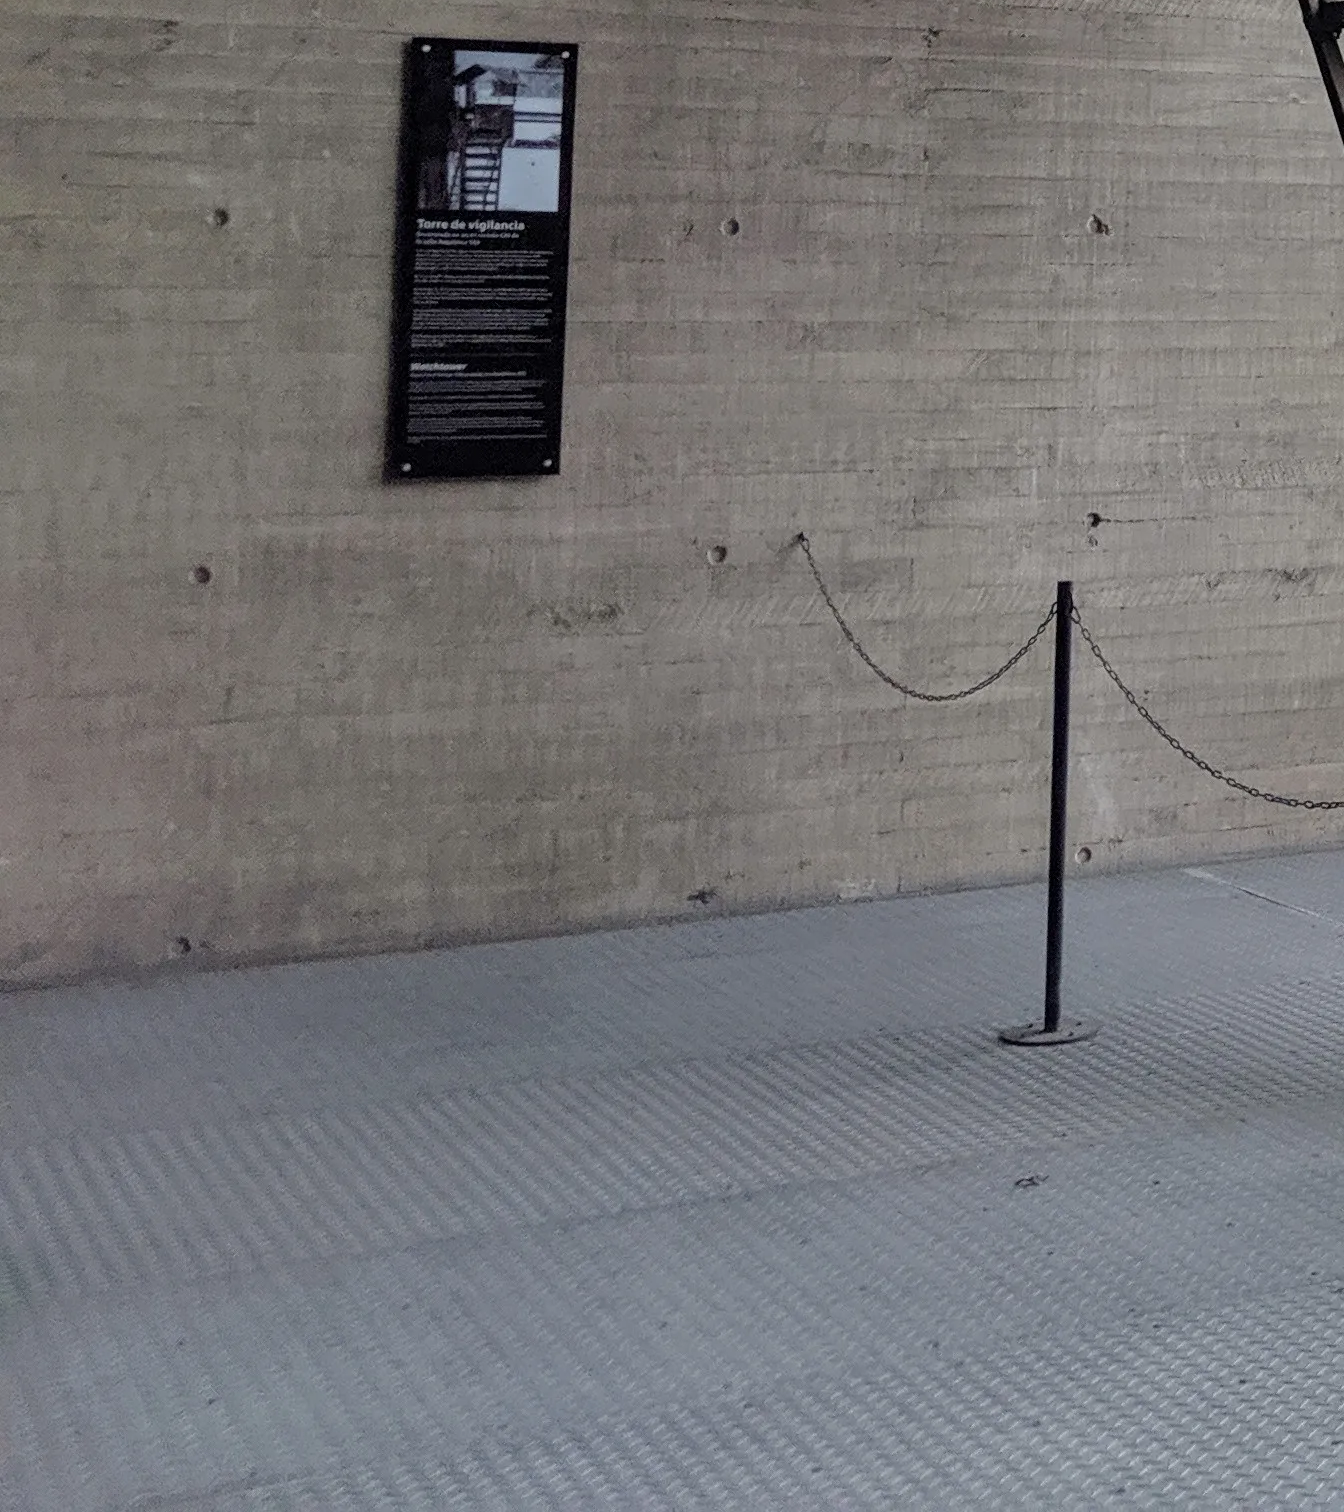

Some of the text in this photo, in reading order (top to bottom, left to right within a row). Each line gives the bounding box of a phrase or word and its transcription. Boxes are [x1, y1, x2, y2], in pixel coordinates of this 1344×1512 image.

[416, 218, 525, 233] Torre de vigilancia
